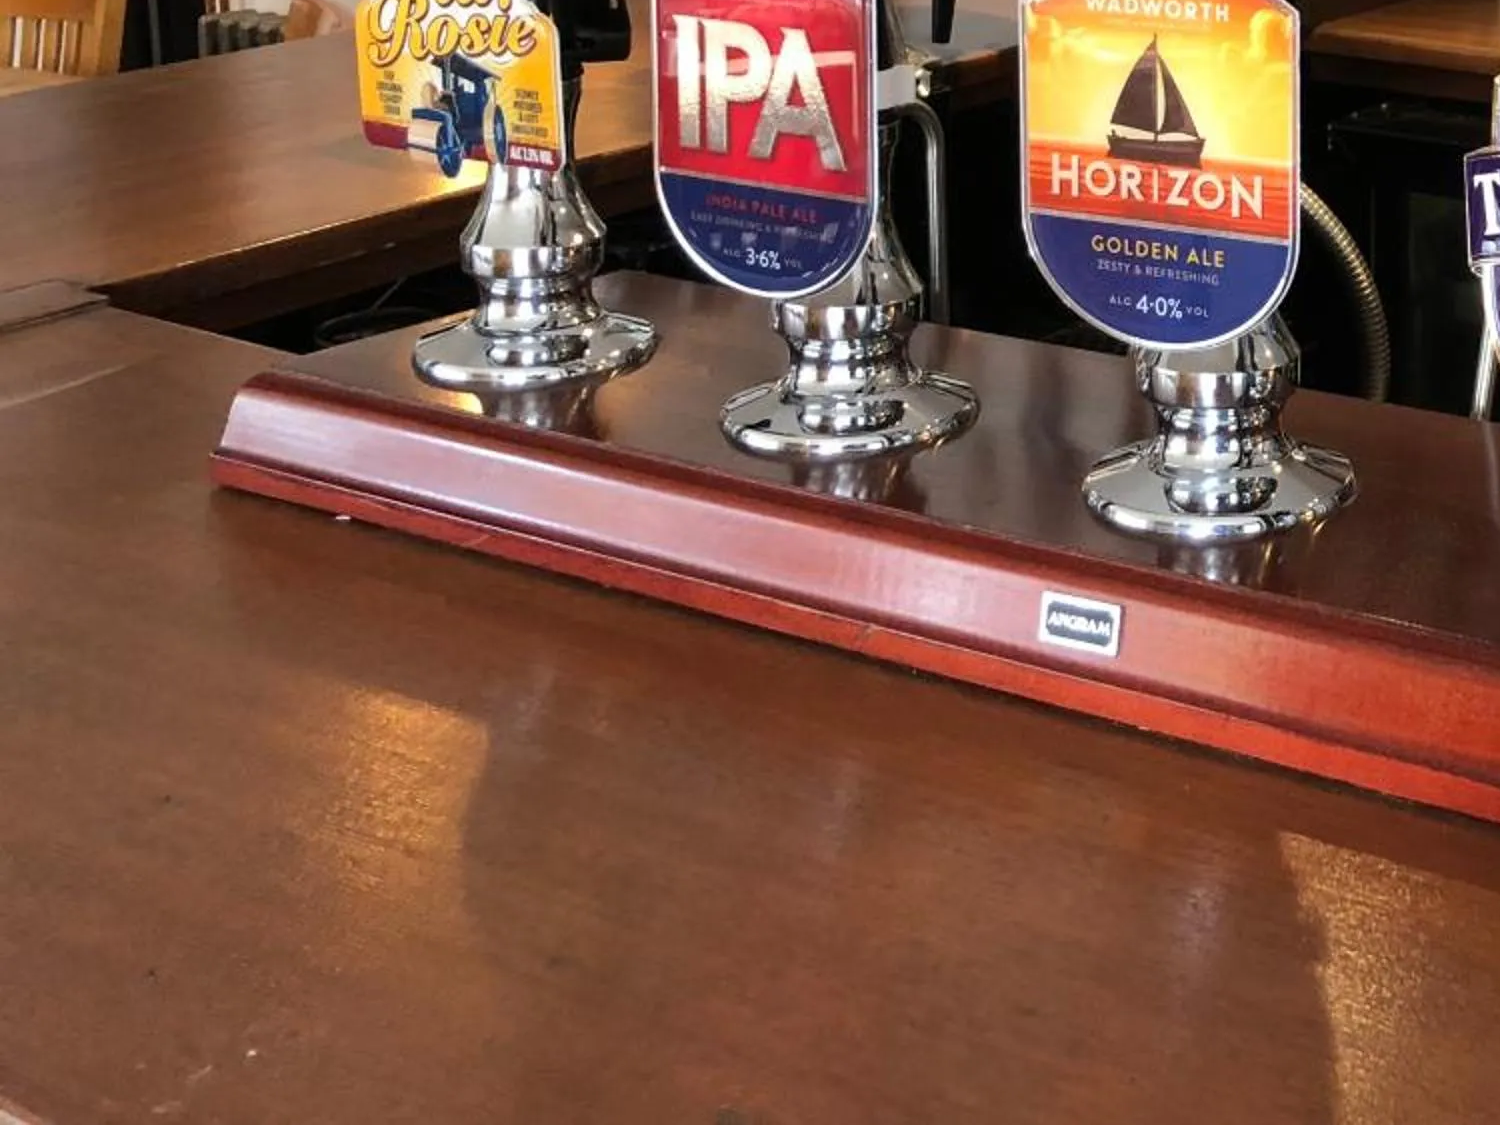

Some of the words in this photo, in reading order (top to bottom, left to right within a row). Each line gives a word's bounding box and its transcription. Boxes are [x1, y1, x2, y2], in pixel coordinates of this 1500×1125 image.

[671, 13, 847, 172] IPA
[1051, 152, 1264, 220] HORIZON
[751, 201, 785, 219] PALE
[792, 208, 817, 224] ALE
[1091, 234, 1178, 260] GOLDEN
[1186, 248, 1226, 268] ALE
[1096, 258, 1132, 275] ZESTY
[1134, 265, 1142, 275] &
[1145, 266, 1220, 286] REFRESHING
[1109, 294, 1132, 306] ALC
[1185, 305, 1209, 318] VOL
